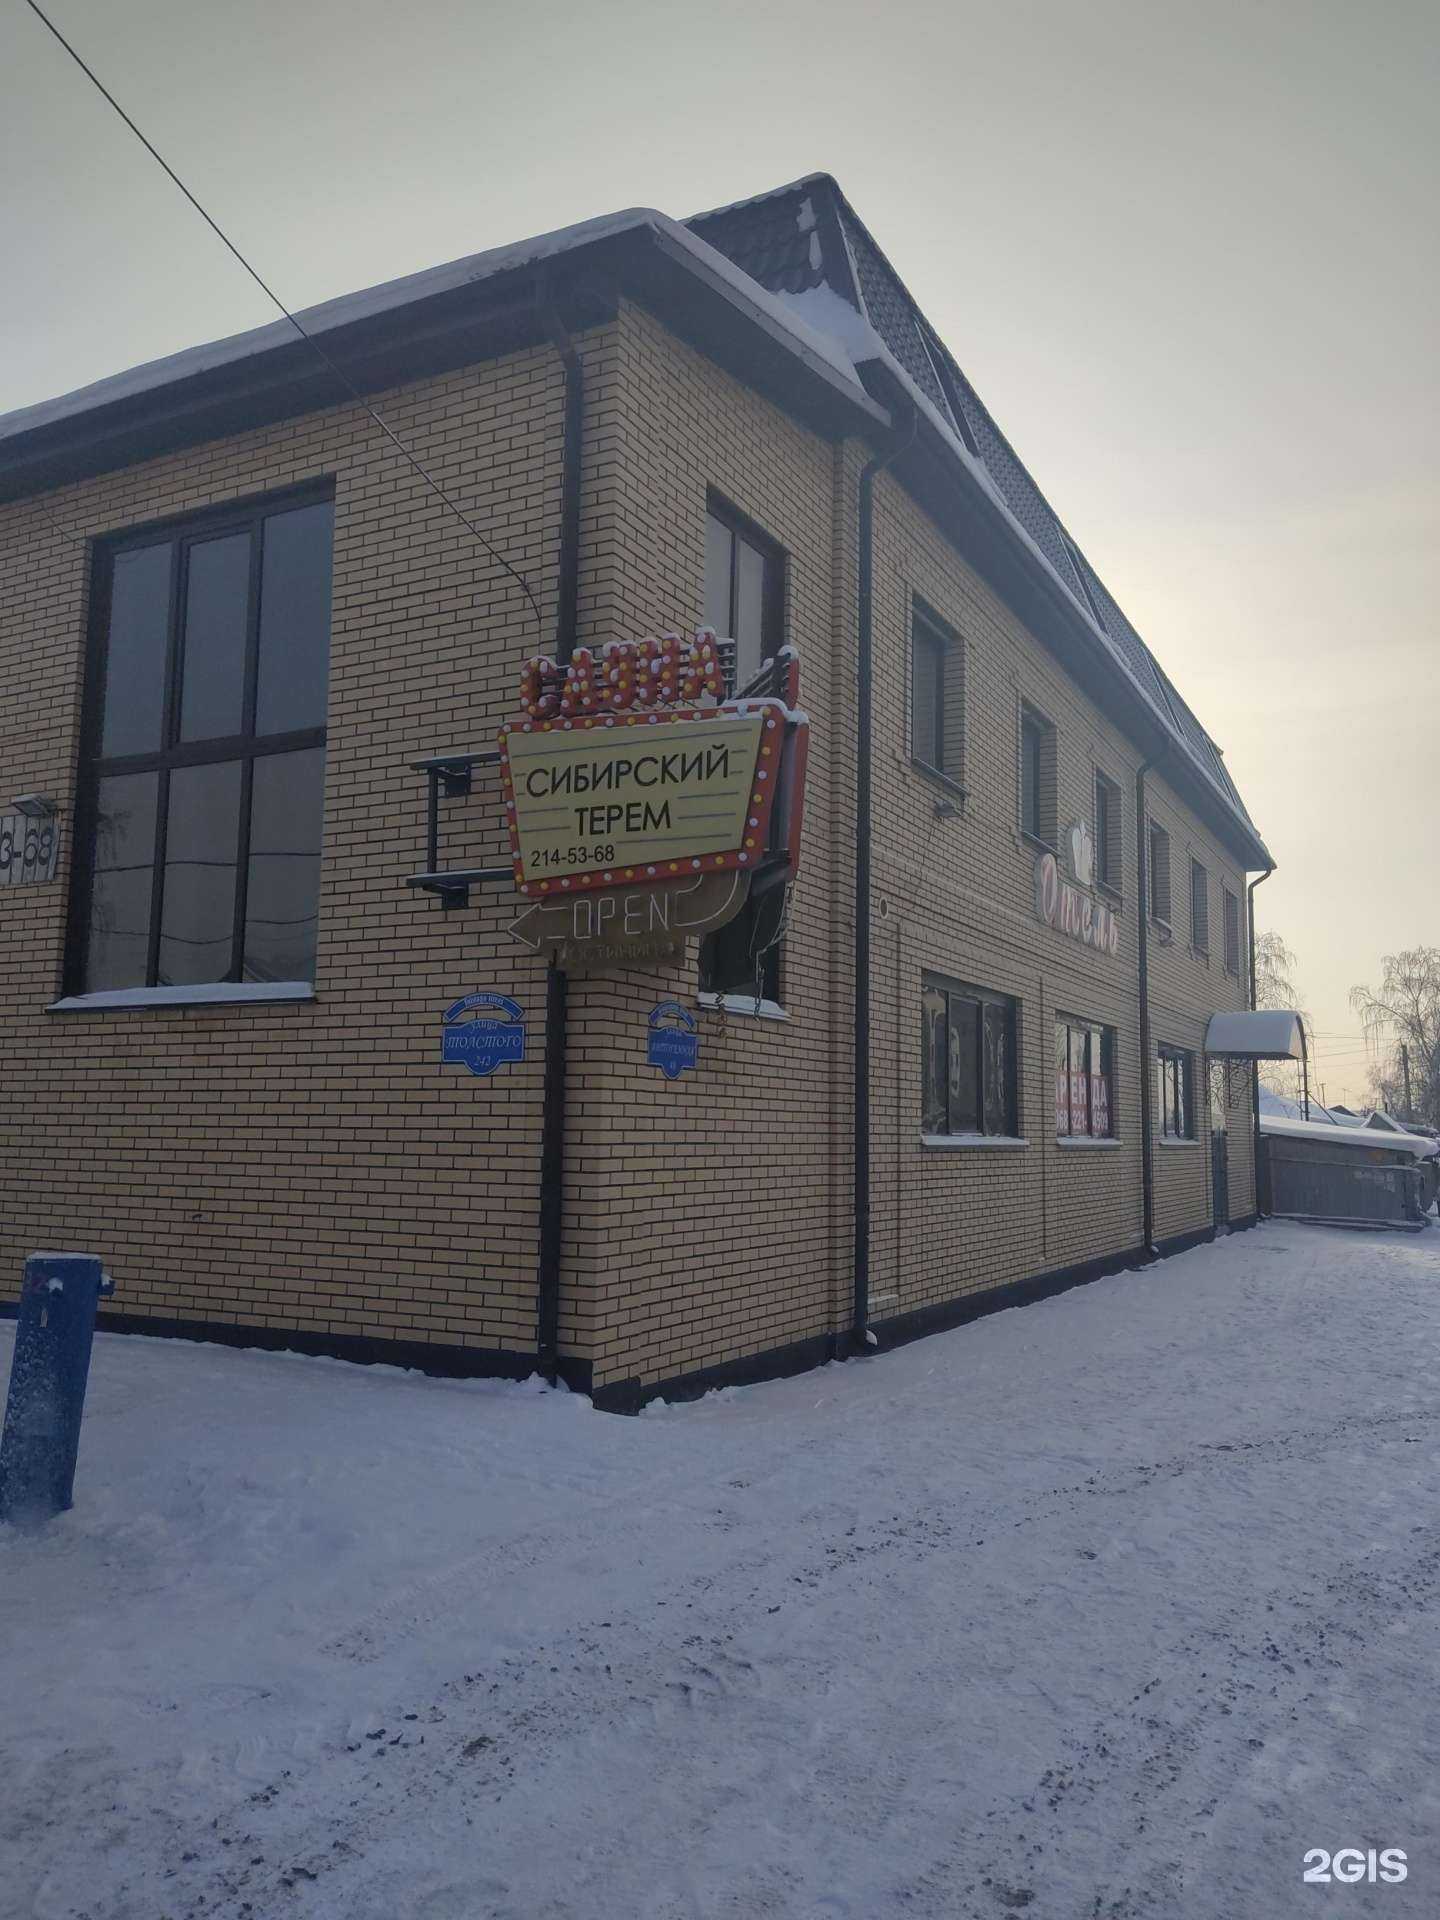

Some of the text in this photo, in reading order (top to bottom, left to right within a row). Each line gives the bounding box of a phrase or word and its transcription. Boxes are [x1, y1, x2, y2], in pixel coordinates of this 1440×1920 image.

[520, 629, 724, 719] САУНА
[526, 744, 729, 798] СИБИРСКИЙ
[574, 800, 671, 836] ТЕРЕМ
[531, 844, 615, 867] 214-53-68
[573, 893, 669, 939] OPEN
